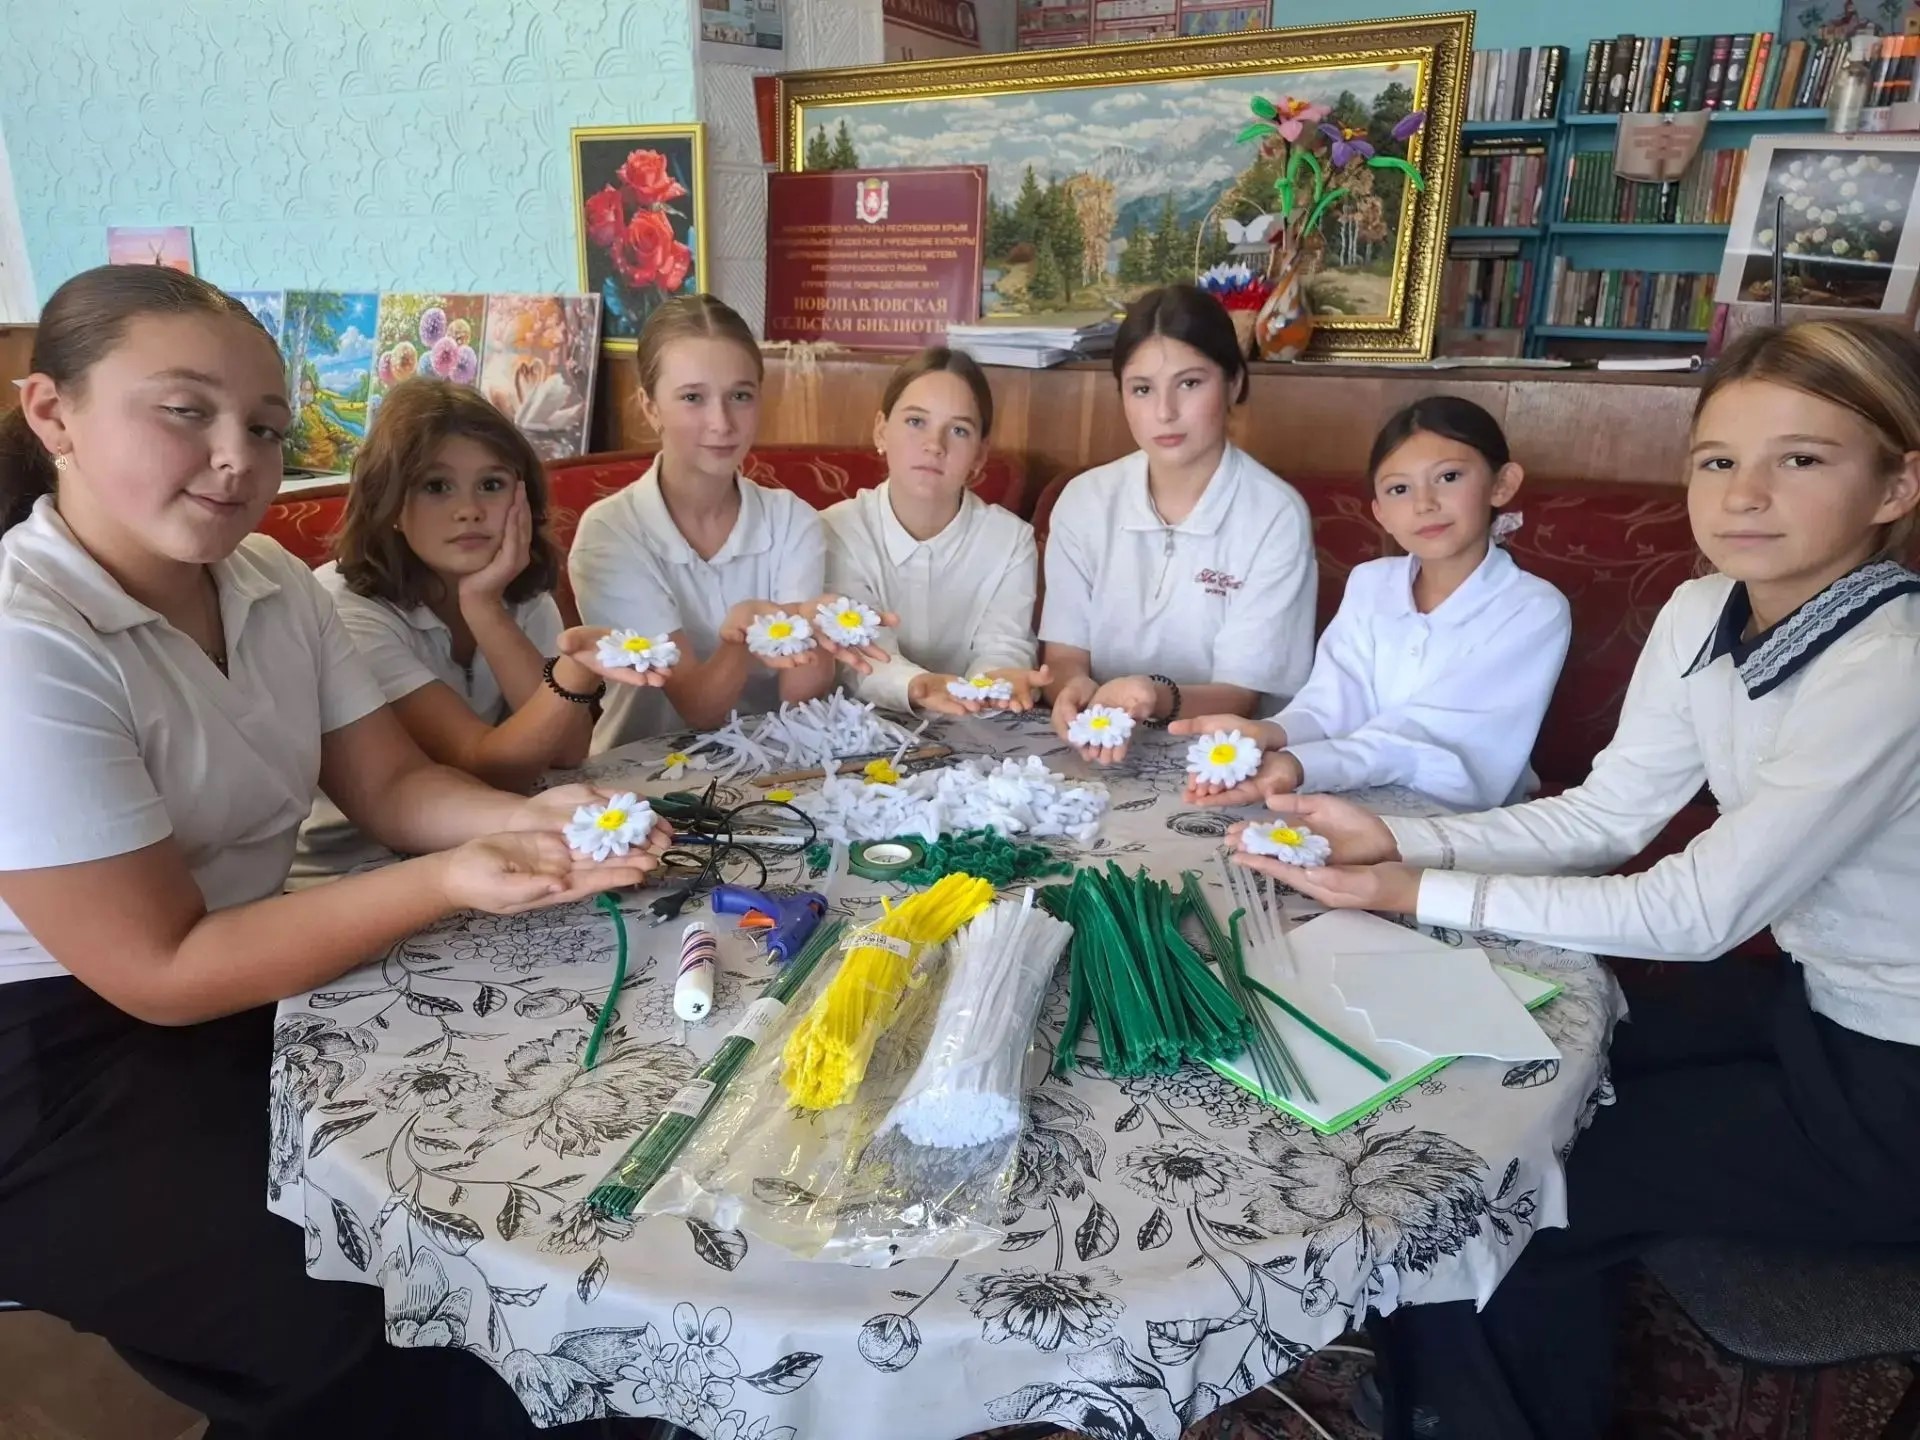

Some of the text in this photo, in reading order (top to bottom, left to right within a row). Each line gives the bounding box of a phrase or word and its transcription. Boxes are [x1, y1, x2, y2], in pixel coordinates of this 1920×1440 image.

[843, 224, 885, 233] КУЛЬТУРЫ
[886, 224, 941, 233] РЕСПУБЛИКИ
[942, 223, 968, 232] КРЫМ
[773, 238, 833, 247] ЦИПАЛЬНОЕ
[794, 297, 948, 313] НОВОПАВЛОВСКАЯ
[772, 316, 966, 334] СЕЛЬСКАЯ БИБЛИОТЕ
